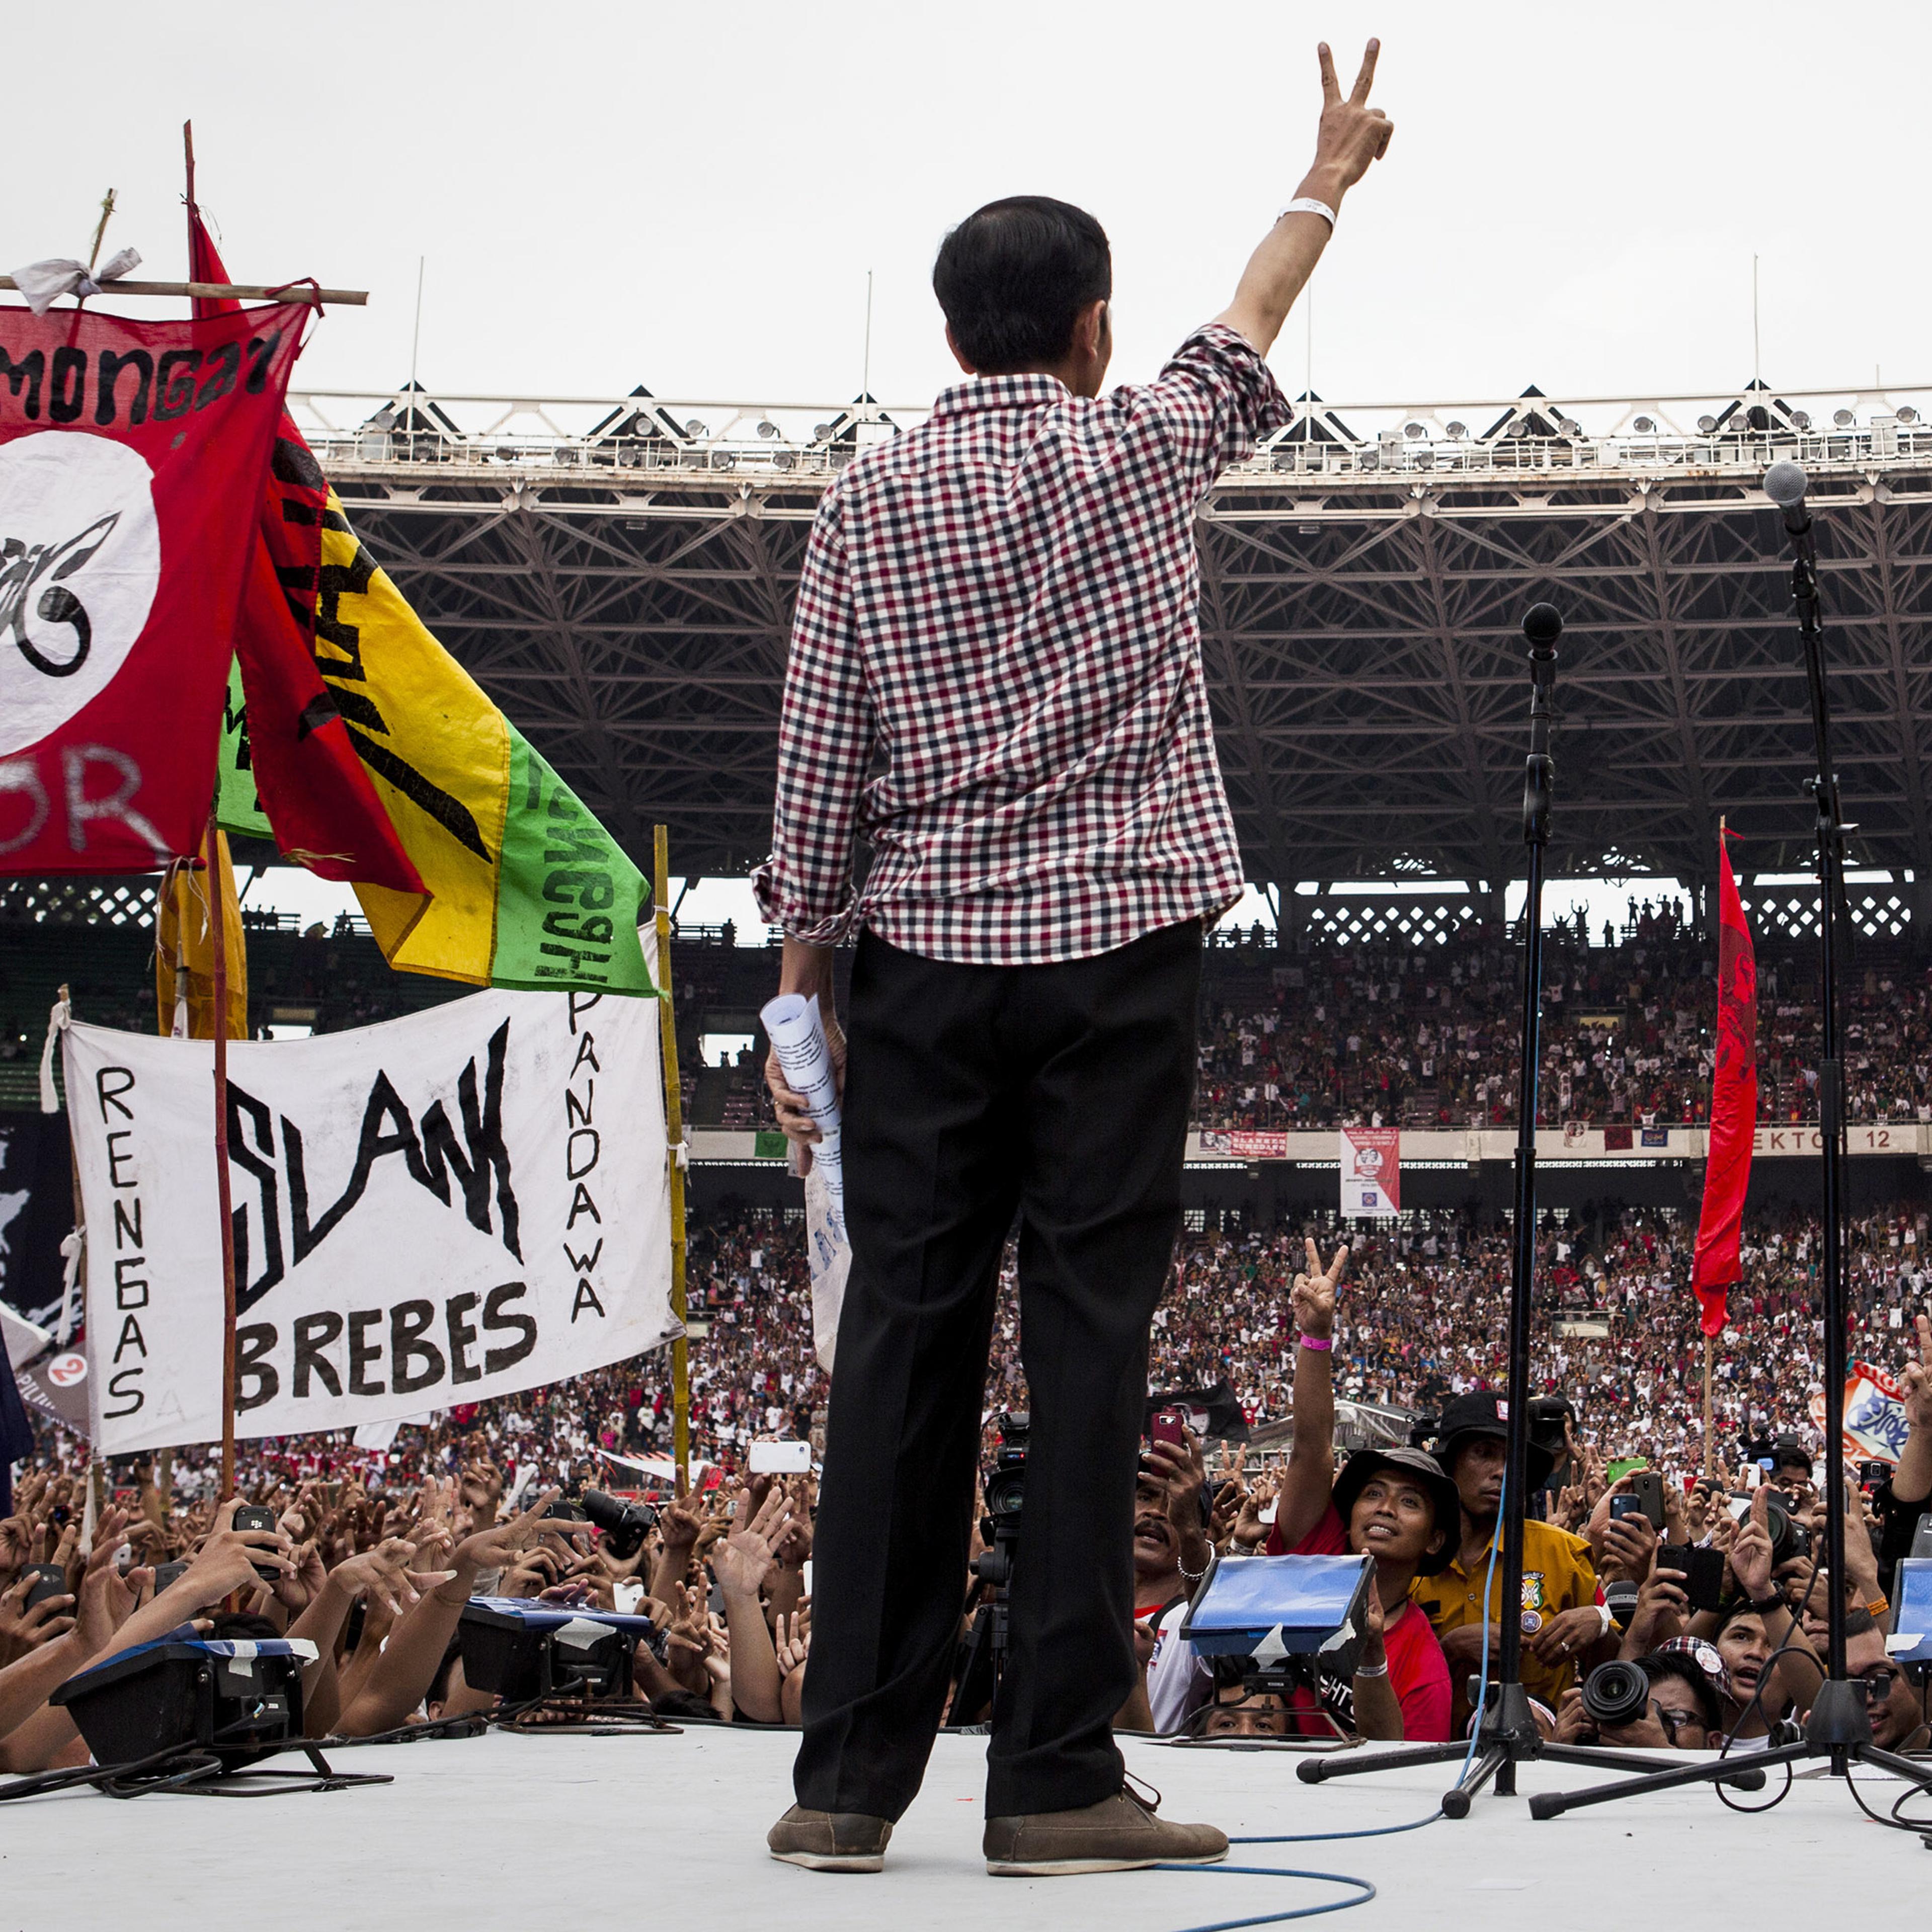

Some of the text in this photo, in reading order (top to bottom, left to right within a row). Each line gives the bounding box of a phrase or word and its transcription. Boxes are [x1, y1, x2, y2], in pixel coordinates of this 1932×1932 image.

[564, 992, 605, 1324] PANDAWA
[1866, 1131, 1890, 1148] 12
[52, 1358, 84, 1382] 2
[235, 1281, 537, 1416] BREBES
